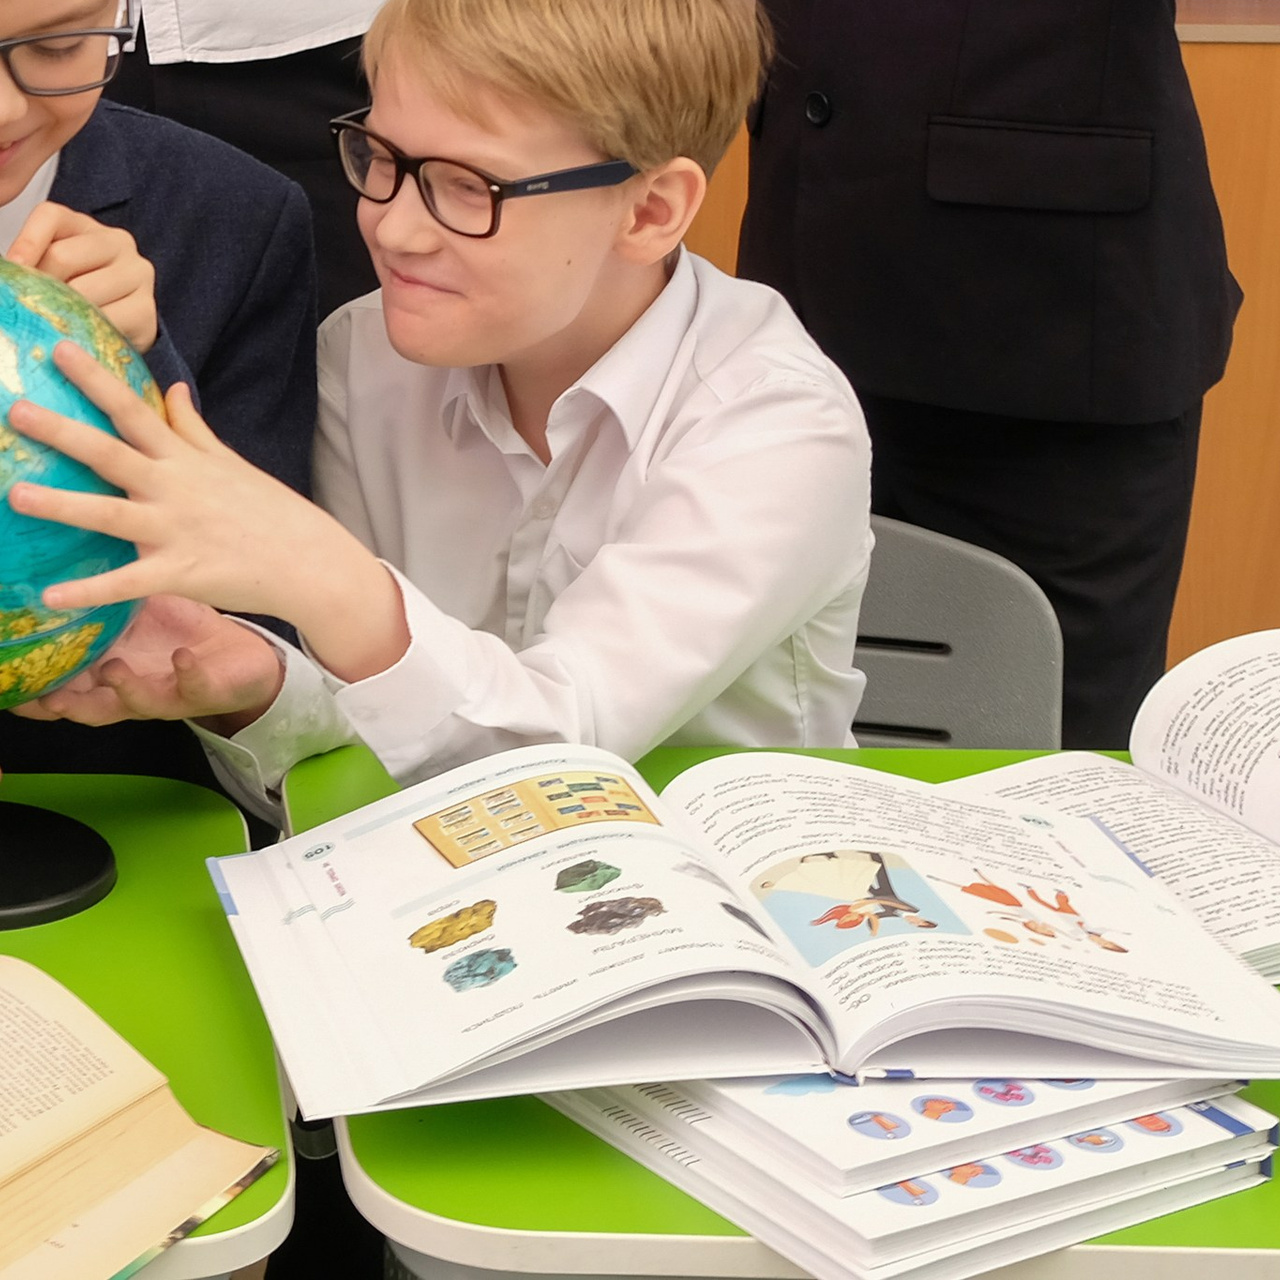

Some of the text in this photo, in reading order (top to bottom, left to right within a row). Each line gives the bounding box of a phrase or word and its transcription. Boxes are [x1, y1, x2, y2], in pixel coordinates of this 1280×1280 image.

[1220, 702, 1258, 739] Простуда
[1190, 742, 1203, 764] тебе
[302, 843, 335, 860] 105
